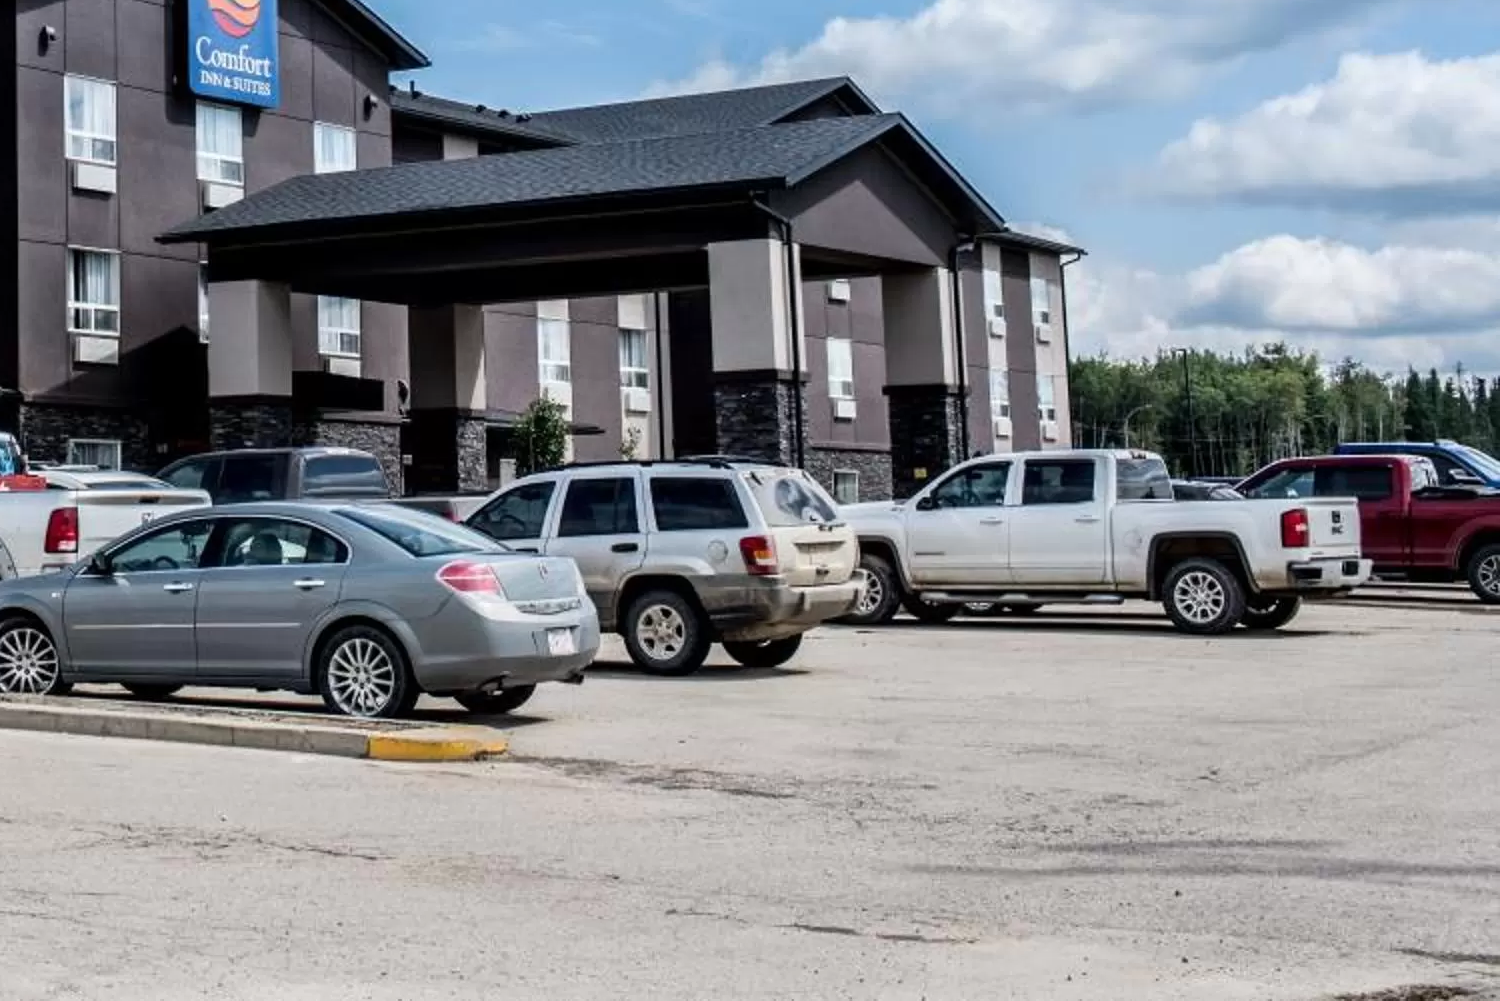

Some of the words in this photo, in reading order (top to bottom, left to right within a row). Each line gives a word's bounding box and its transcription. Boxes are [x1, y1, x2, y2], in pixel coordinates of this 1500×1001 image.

[195, 35, 272, 78] Comfort
[200, 69, 222, 87] INN
[232, 76, 271, 96] SUITES
